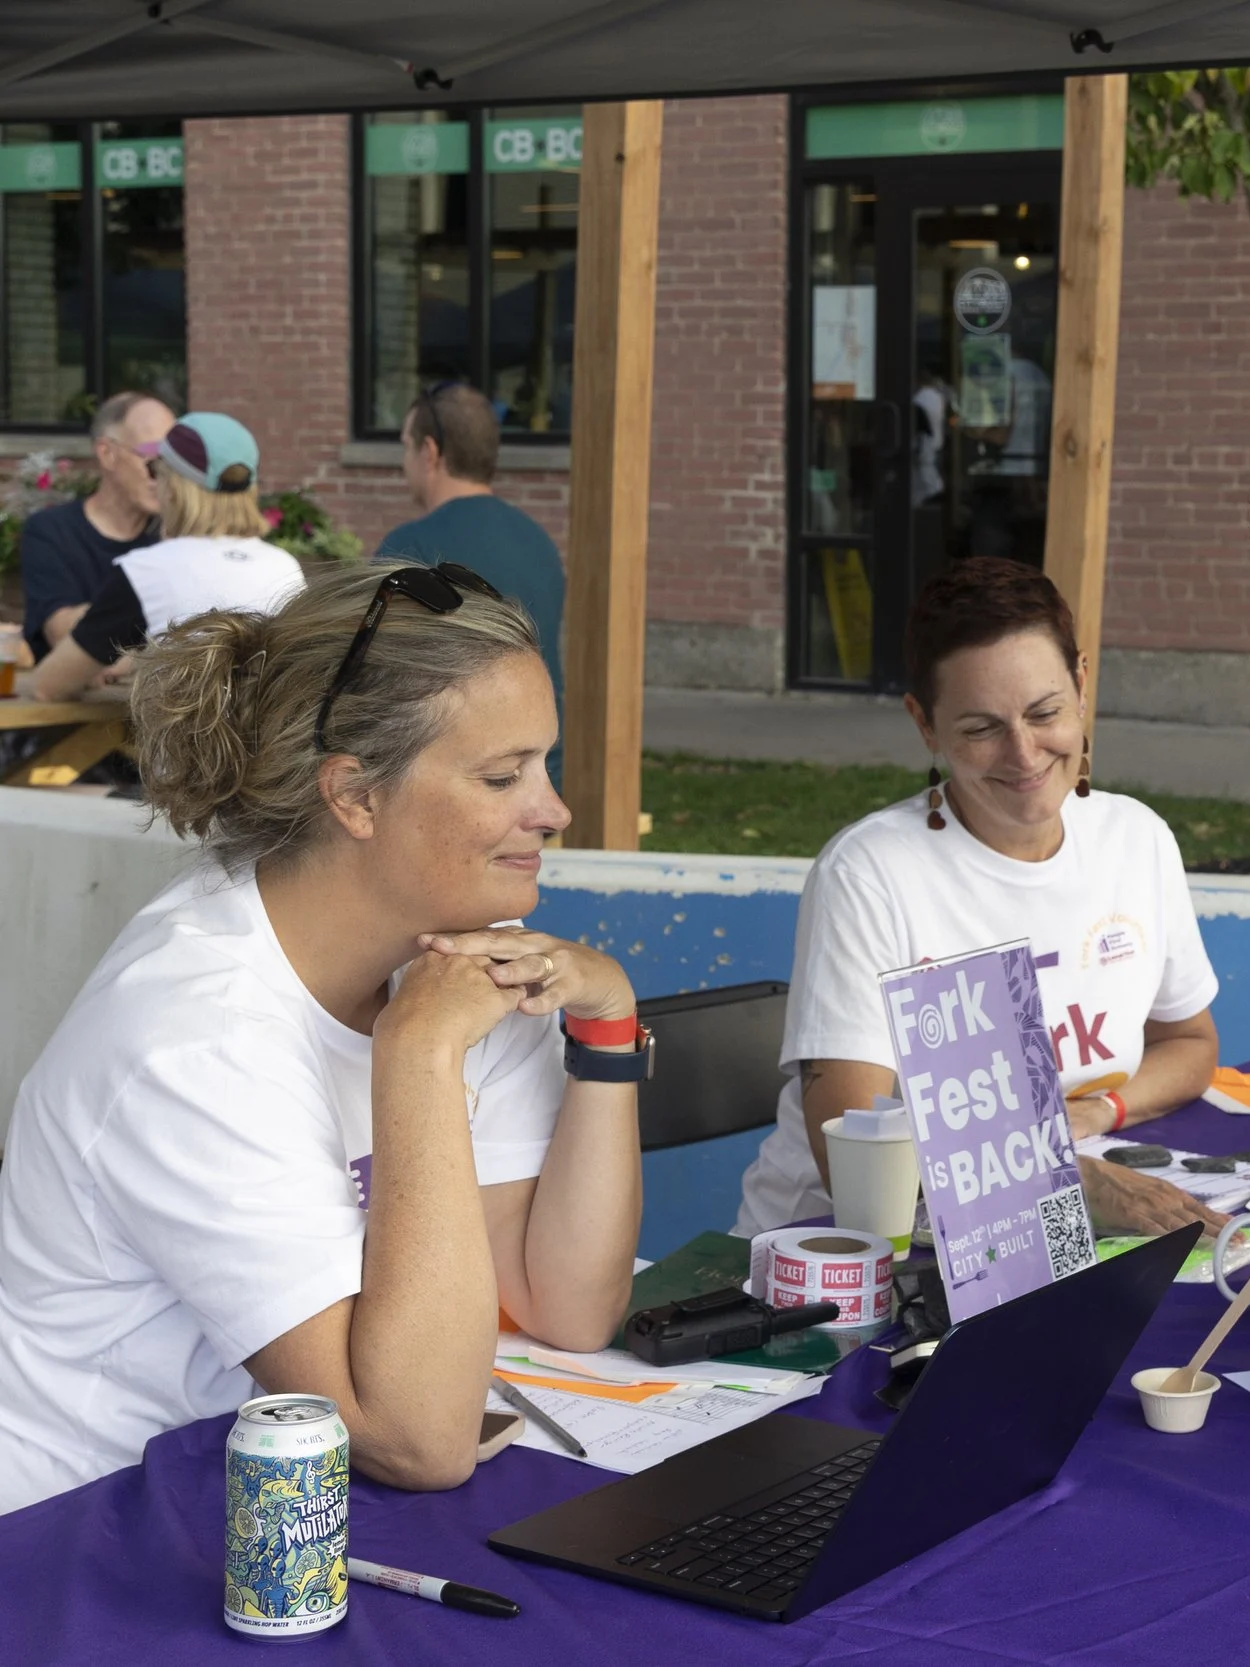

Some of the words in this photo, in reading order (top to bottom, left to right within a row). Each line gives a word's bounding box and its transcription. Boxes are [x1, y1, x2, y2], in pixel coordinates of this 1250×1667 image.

[493, 129, 534, 162] CB
[103, 148, 138, 180] CB
[147, 146, 182, 178] BC
[889, 970, 995, 1056] Fork
[1050, 1003, 1115, 1072] rk
[907, 1051, 1020, 1142] Fest
[925, 1156, 949, 1191] is
[949, 1112, 1074, 1205] BACK!
[993, 1219, 1012, 1234] 4PM
[1018, 1208, 1037, 1225] 7PM
[953, 1251, 985, 1277] CITY
[999, 1230, 1034, 1258] BUILT
[775, 1260, 805, 1281] TICKET
[824, 1269, 861, 1283] TICKET
[778, 1292, 798, 1302] KEEP
[837, 1312, 860, 1320] UPON
[238, 1618, 261, 1627] SPARKLING
